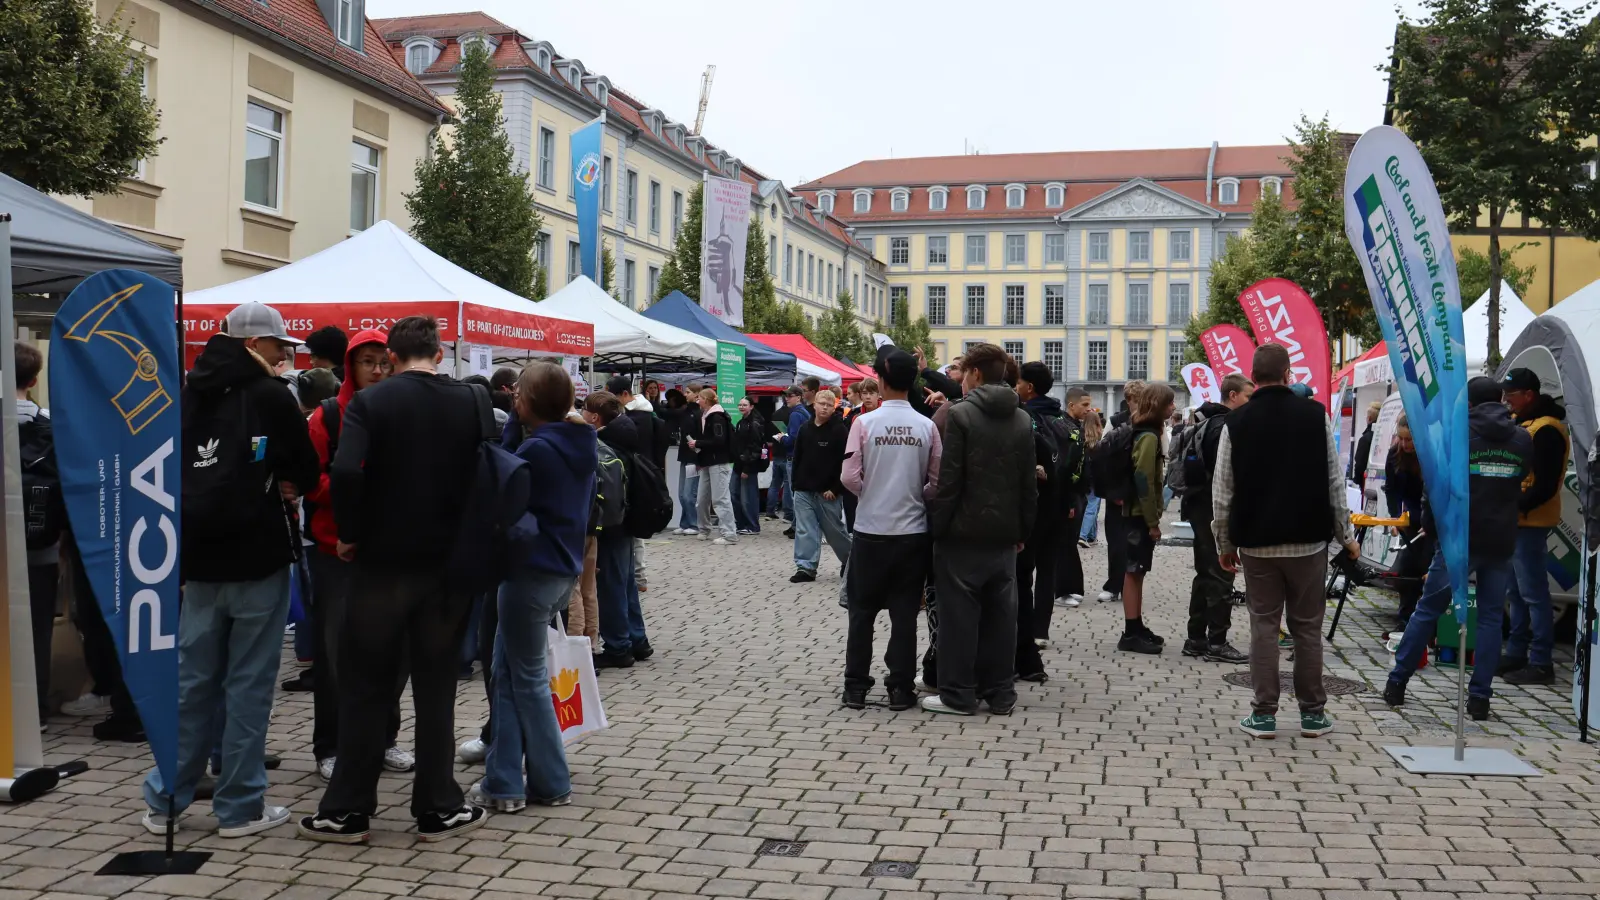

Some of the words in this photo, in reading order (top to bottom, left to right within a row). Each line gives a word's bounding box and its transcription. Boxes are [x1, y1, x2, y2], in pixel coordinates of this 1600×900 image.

[1385, 156, 1410, 195] Cool
[1402, 193, 1426, 230] and
[1413, 231, 1440, 279] fresh
[1387, 209, 1397, 228] mit
[1393, 227, 1405, 257] Profis
[1402, 256, 1412, 282] Kälte
[1410, 283, 1420, 302] und
[1416, 302, 1427, 332] Klima
[200, 319, 215, 331] OF
[466, 320, 476, 332] BE
[477, 321, 492, 334] PART
[493, 323, 502, 336] OF
[1432, 282, 1454, 371] Company
[556, 332, 592, 347] LOXXESS
[874, 436, 923, 448] RWANDA
[884, 426, 913, 436] VISIT
[98, 459, 106, 482] UND
[193, 456, 218, 468] adidas
[128, 436, 178, 654] PCA
